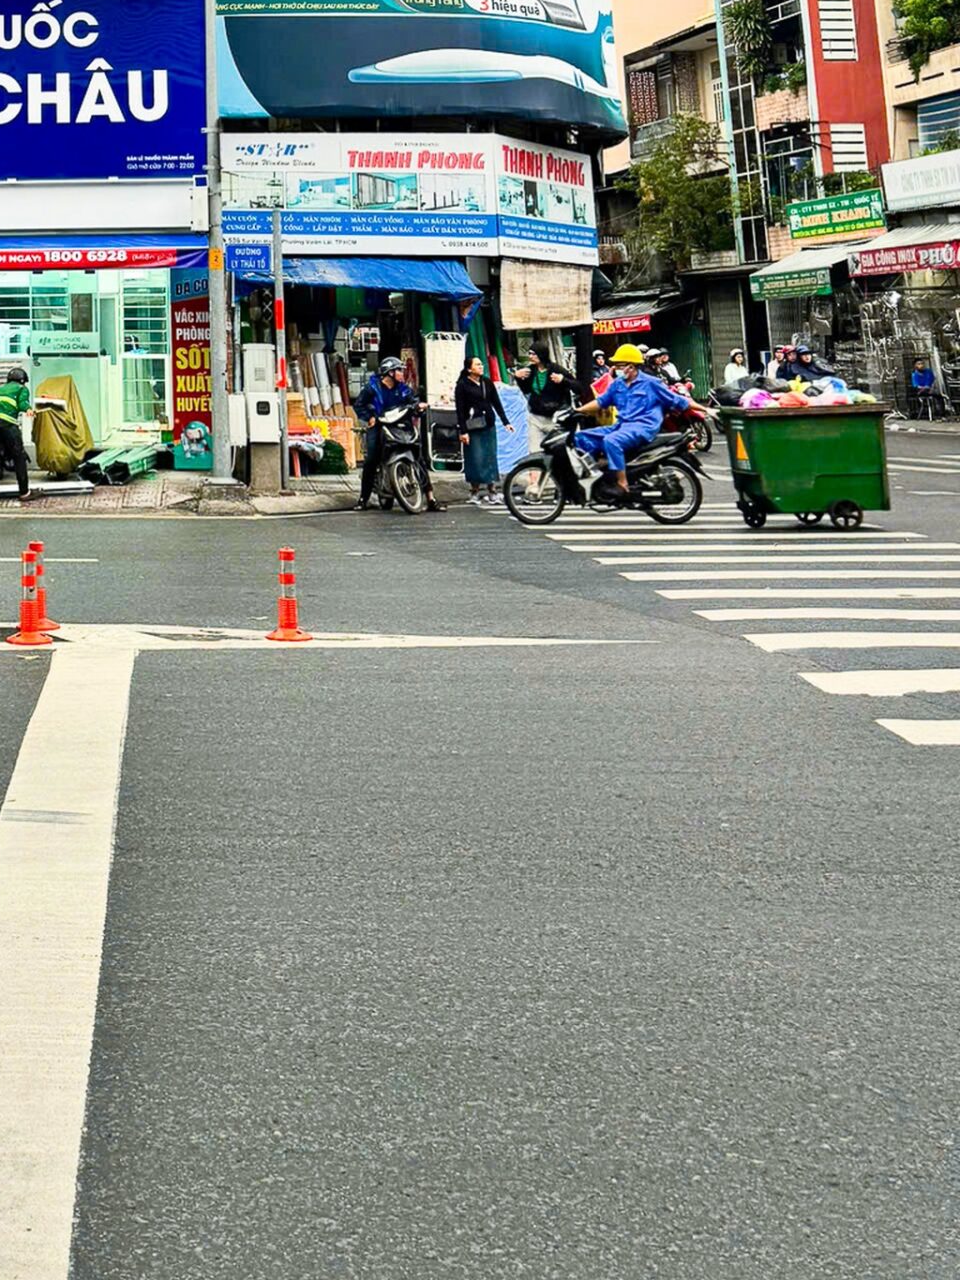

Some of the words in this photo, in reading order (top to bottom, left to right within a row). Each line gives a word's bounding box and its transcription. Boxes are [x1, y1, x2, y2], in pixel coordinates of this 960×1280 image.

[519, 2, 540, 18] quả
[347, 150, 413, 169] THANH
[417, 149, 486, 170] PHONG
[502, 144, 543, 179] THANH
[545, 151, 585, 187] PHONG
[43, 250, 83, 263] 1800
[86, 249, 128, 262] 6928
[235, 246, 262, 256] ĐƯỜNG
[861, 253, 875, 268] GIA
[875, 249, 897, 267] CÔNG
[240, 257, 256, 269] THÁI
[174, 306, 195, 323] VẮC
[176, 324, 211, 341] PHÒNG
[175, 341, 211, 370] SỐT
[176, 372, 213, 393] XUẤT
[176, 394, 213, 412] HUYẾT
